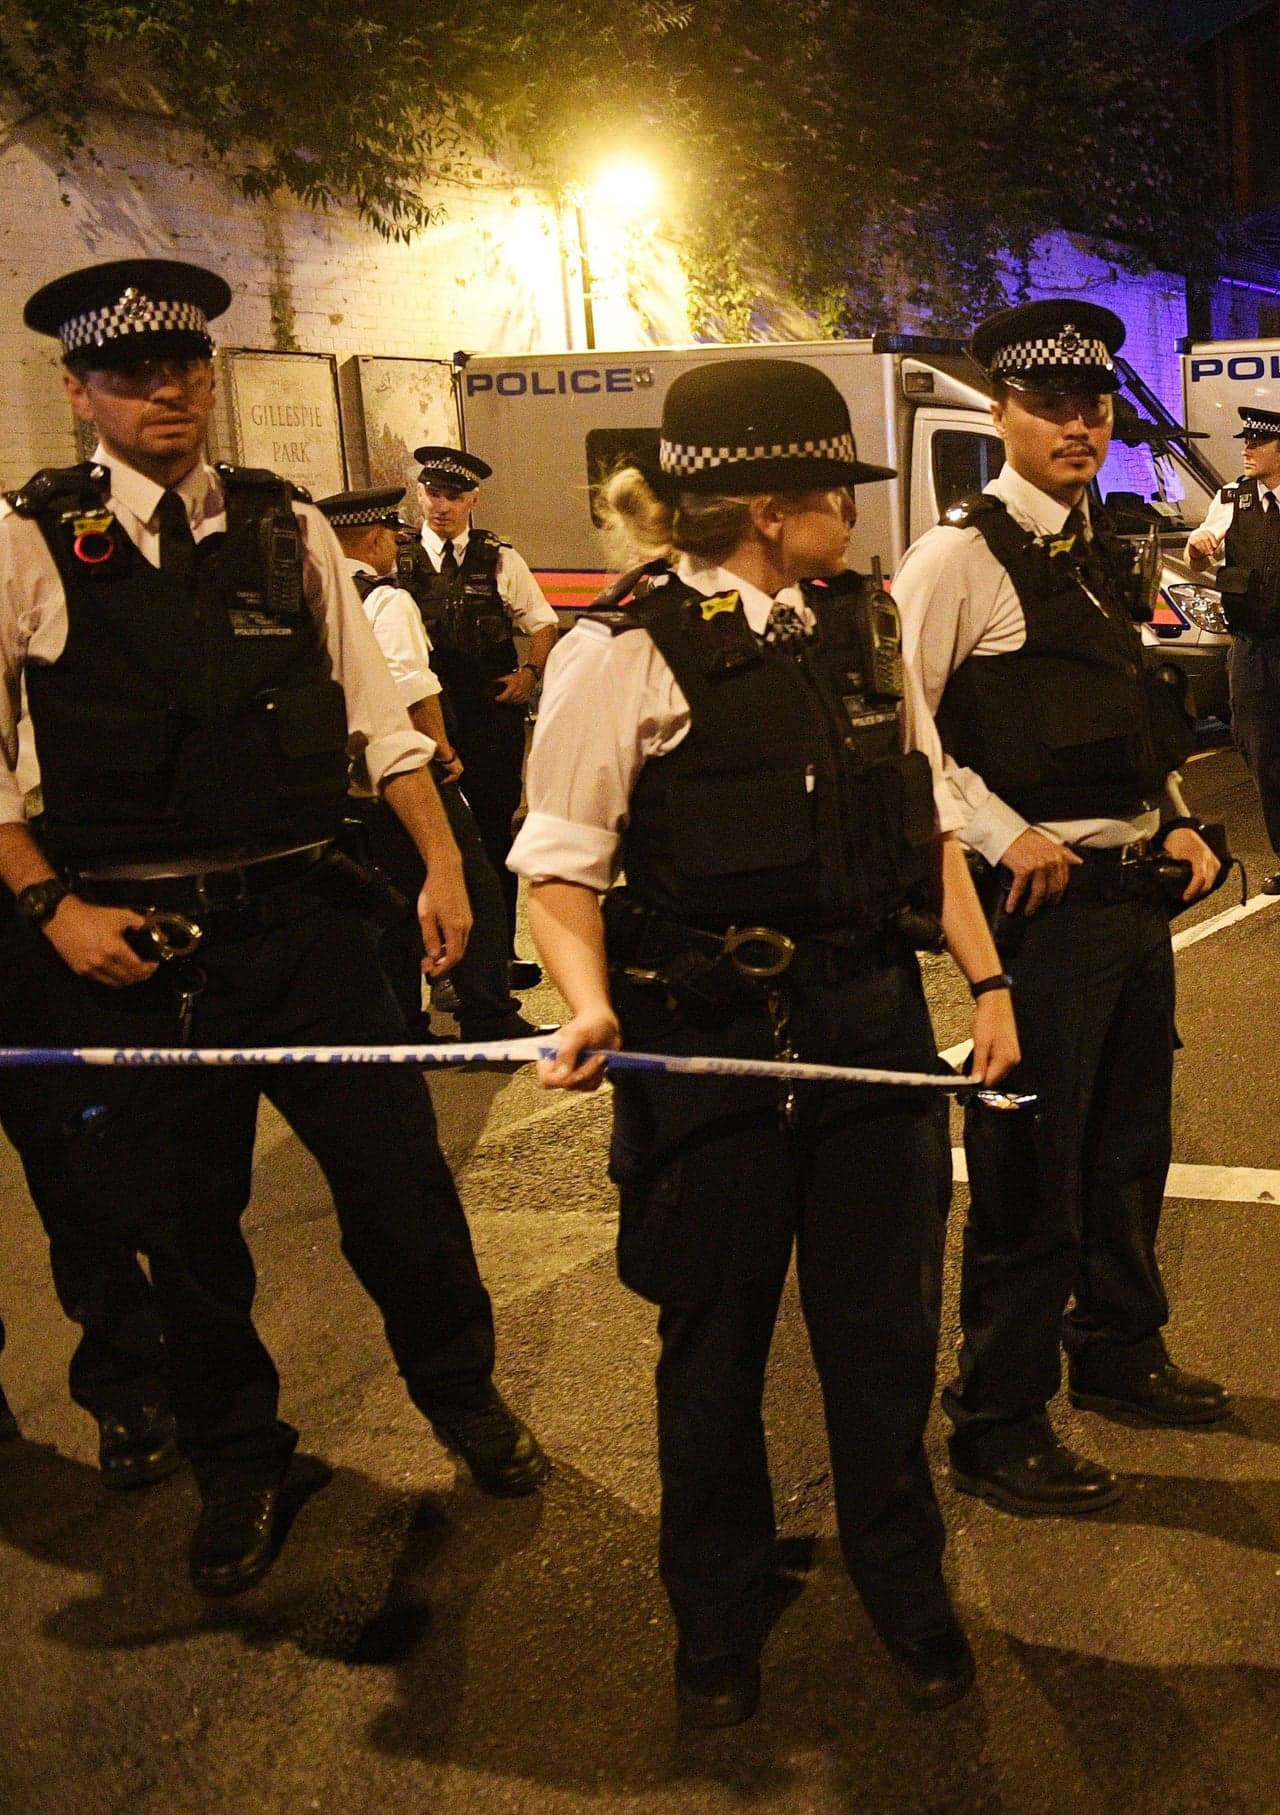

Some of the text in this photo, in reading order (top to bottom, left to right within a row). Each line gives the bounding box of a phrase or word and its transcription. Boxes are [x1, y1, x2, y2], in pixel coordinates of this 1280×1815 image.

[467, 368, 633, 397] POLICE
[251, 404, 323, 428] GILLESPIE
[272, 441, 311, 463] PARK
